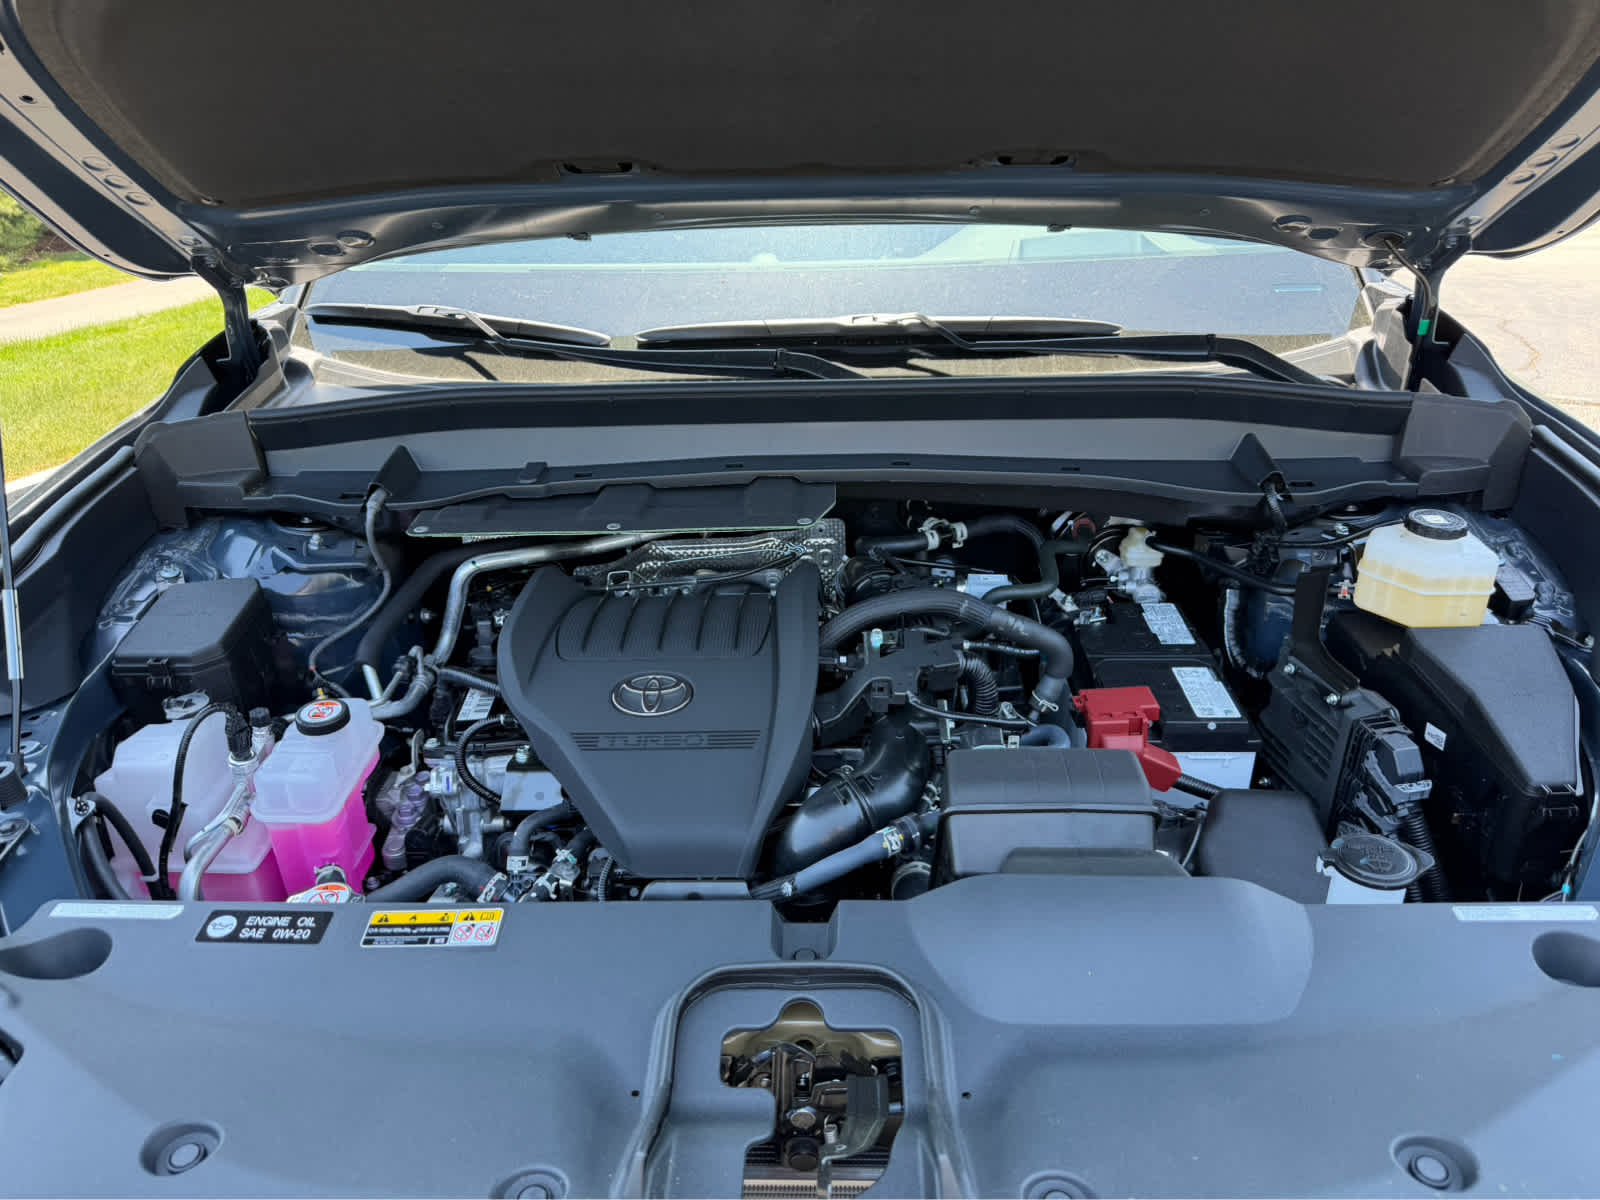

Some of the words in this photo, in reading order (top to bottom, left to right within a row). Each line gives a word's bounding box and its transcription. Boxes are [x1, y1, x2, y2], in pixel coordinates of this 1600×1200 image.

[602, 734, 705, 748] TURBO
[245, 915, 292, 926] ENGINE
[297, 916, 316, 927] OIL
[239, 928, 267, 939] SAE
[272, 928, 311, 939] 0W-20
